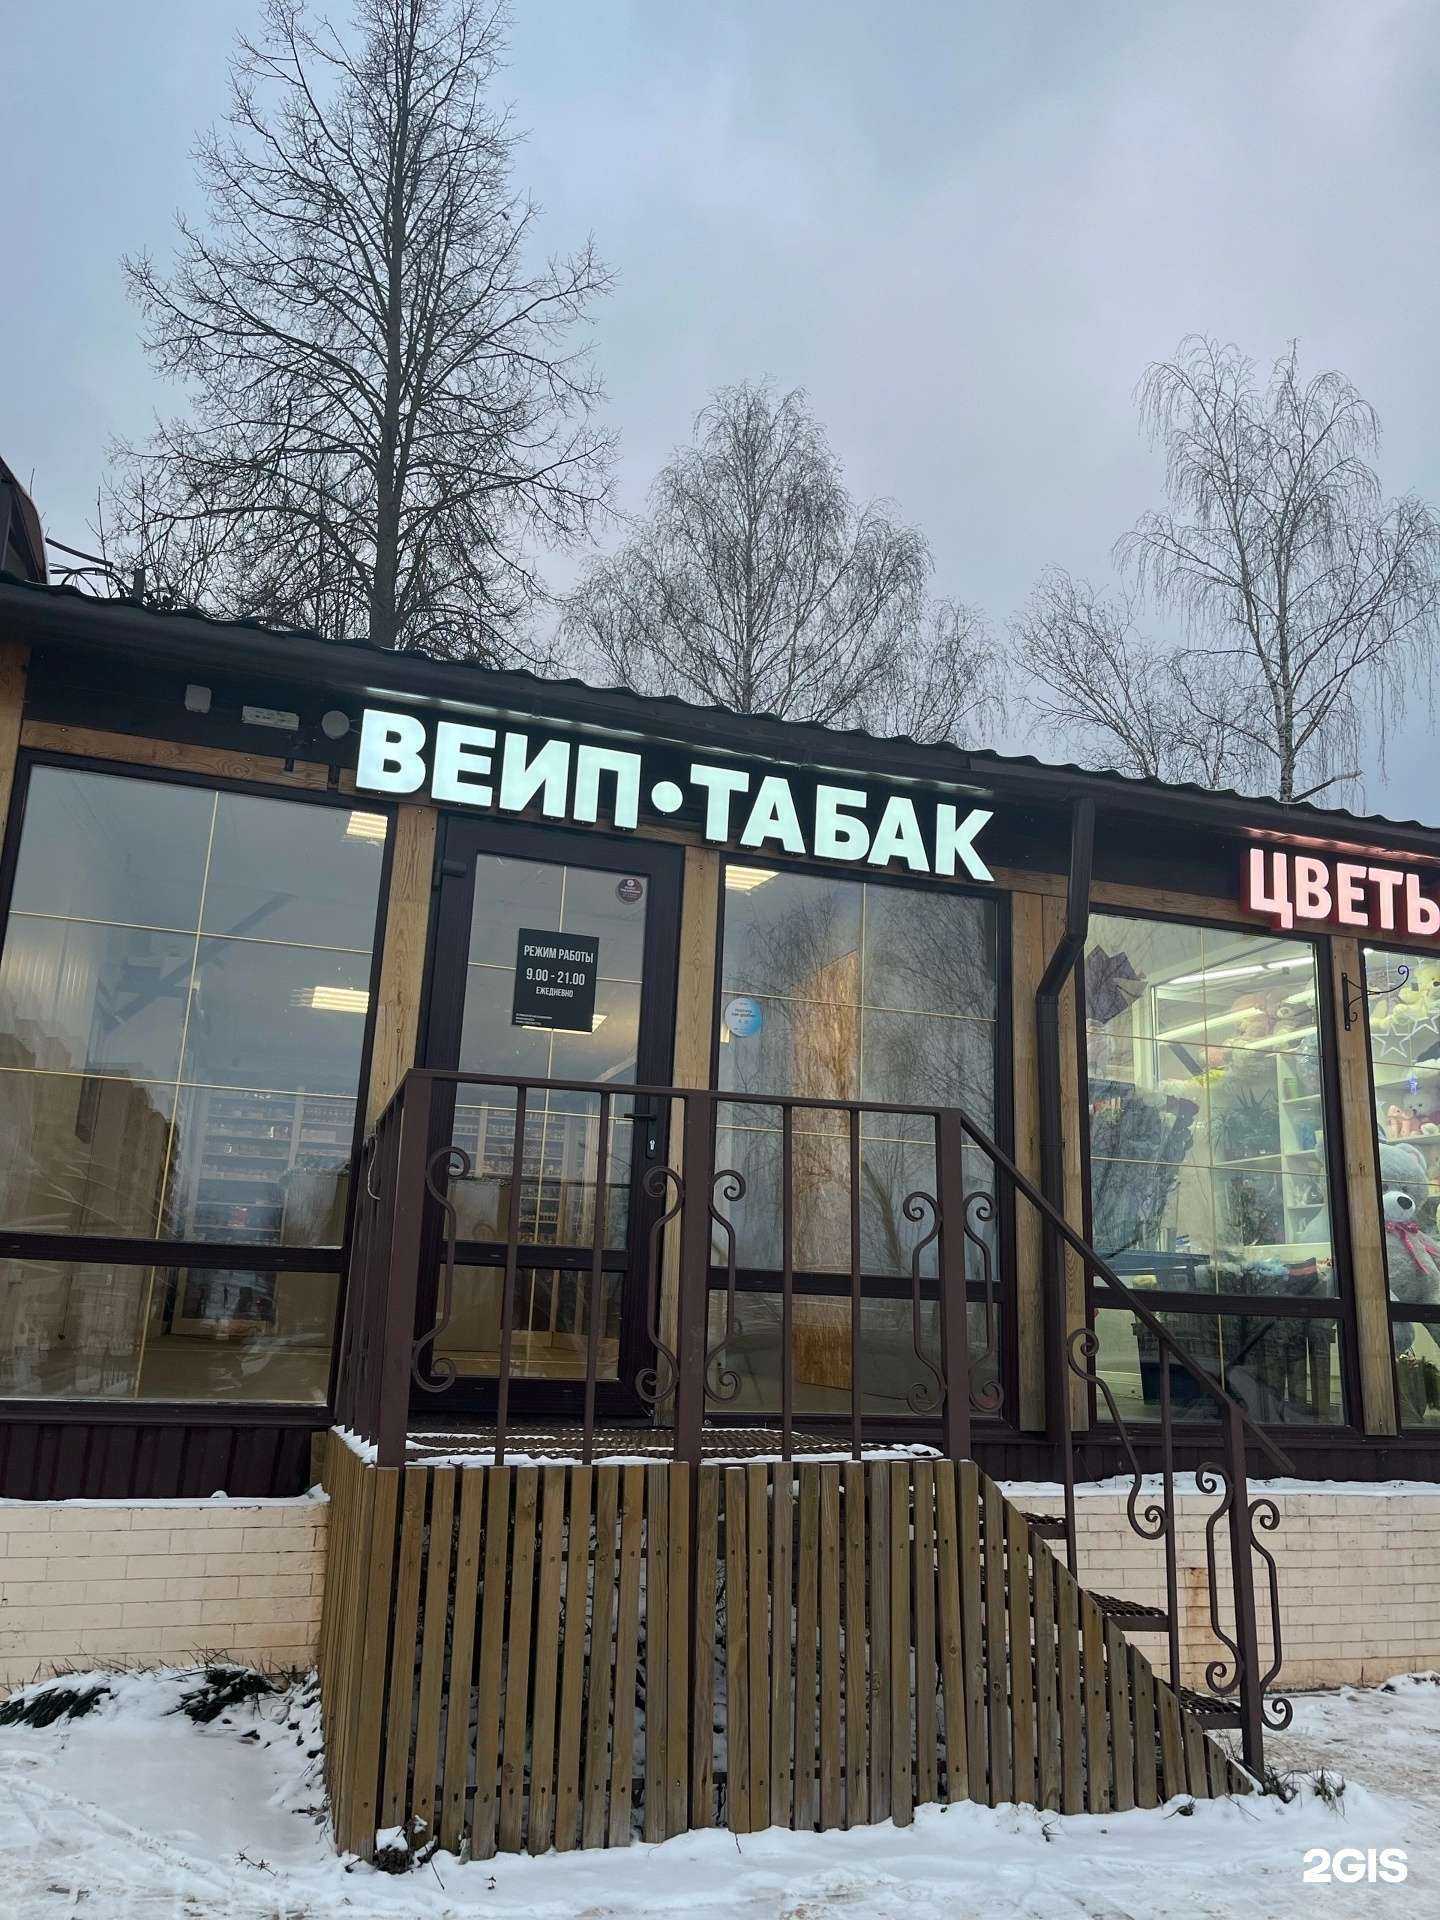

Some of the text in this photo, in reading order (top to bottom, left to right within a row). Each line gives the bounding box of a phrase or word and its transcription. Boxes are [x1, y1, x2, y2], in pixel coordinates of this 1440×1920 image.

[690, 763, 995, 882] ТАБАК
[523, 944, 594, 964] РЕЖИМ РАБОТЫ
[526, 967, 549, 982] 9.00
[556, 970, 586, 986] 21.00
[535, 986, 574, 998] ЕЖЕДНЕВНО
